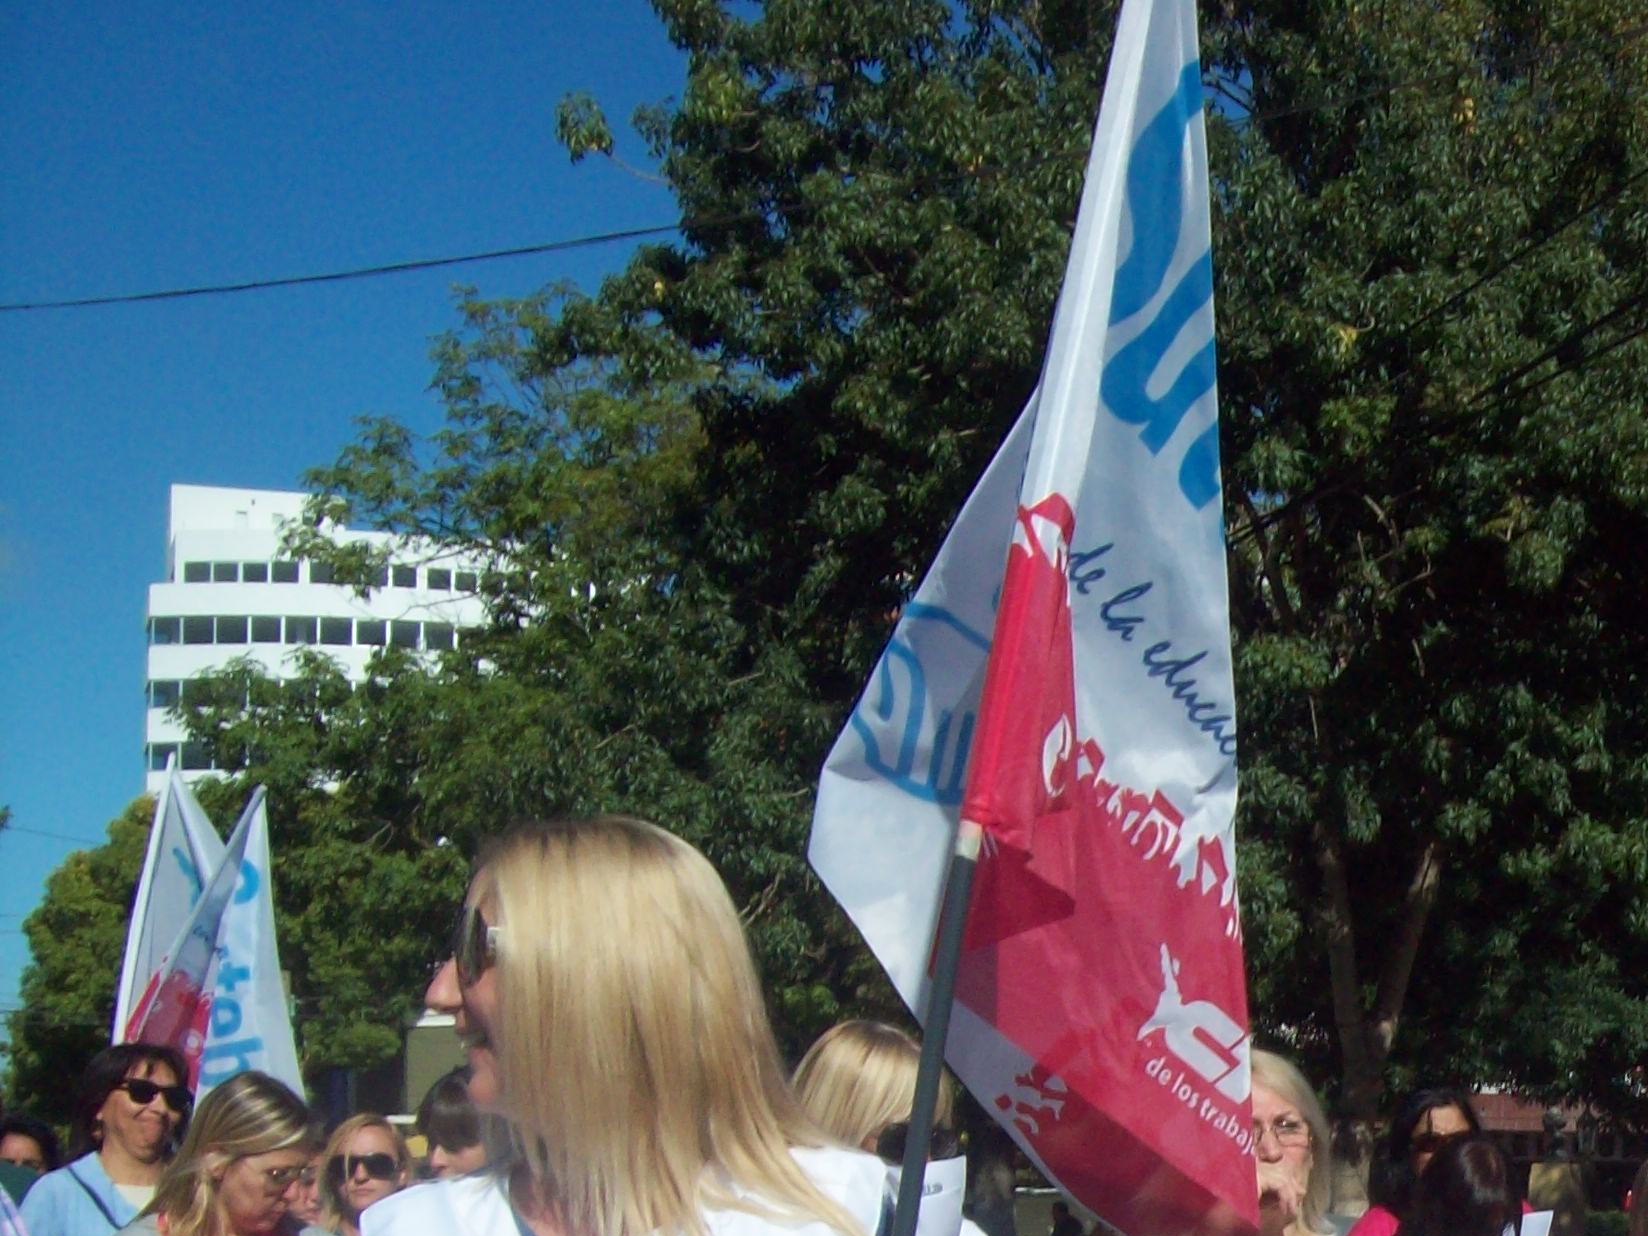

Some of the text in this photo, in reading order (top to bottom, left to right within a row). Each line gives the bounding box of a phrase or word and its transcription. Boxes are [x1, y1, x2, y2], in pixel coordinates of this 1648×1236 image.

[1100, 581, 1154, 642] la
[1145, 1056, 1172, 1086] de
[1171, 1072, 1200, 1110] los
